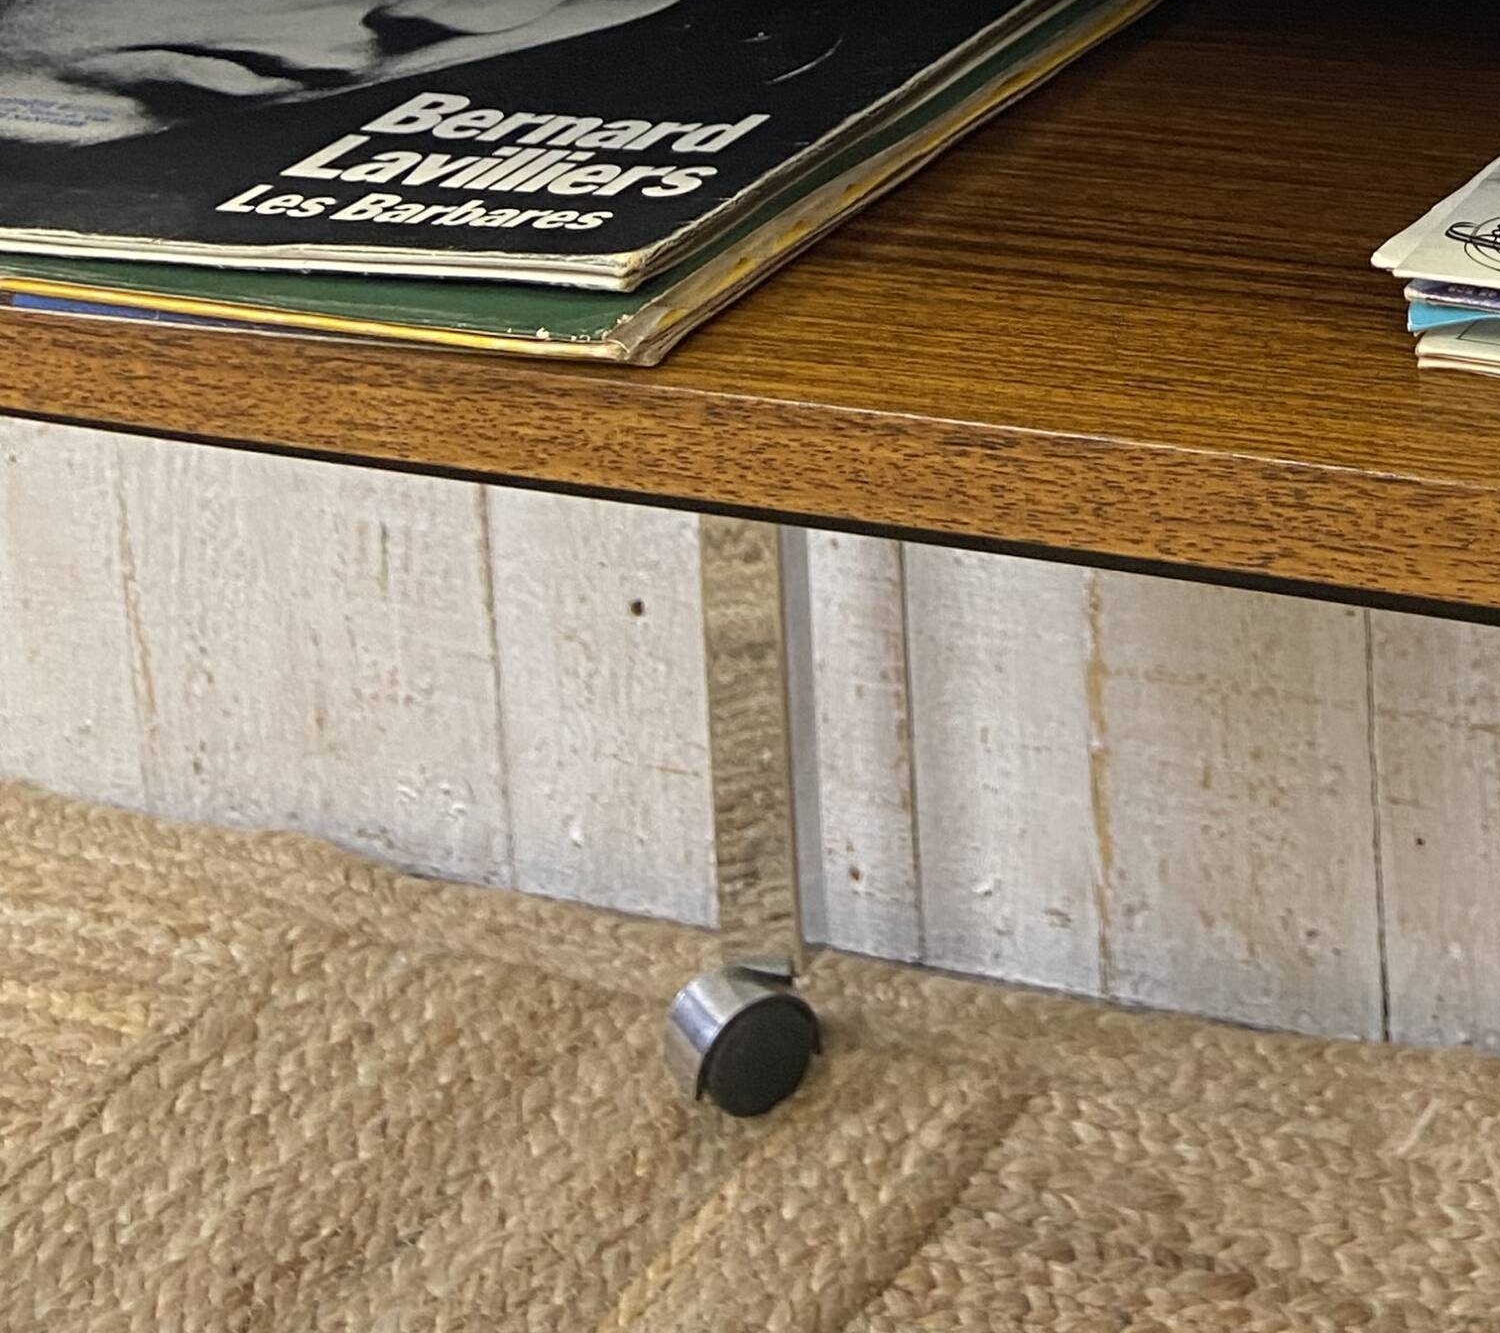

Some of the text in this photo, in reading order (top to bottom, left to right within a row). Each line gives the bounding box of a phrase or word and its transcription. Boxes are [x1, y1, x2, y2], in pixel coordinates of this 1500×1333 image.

[360, 91, 771, 154] Bernard
[279, 134, 718, 198] Lavilliers
[215, 183, 614, 231] Les Barbares
